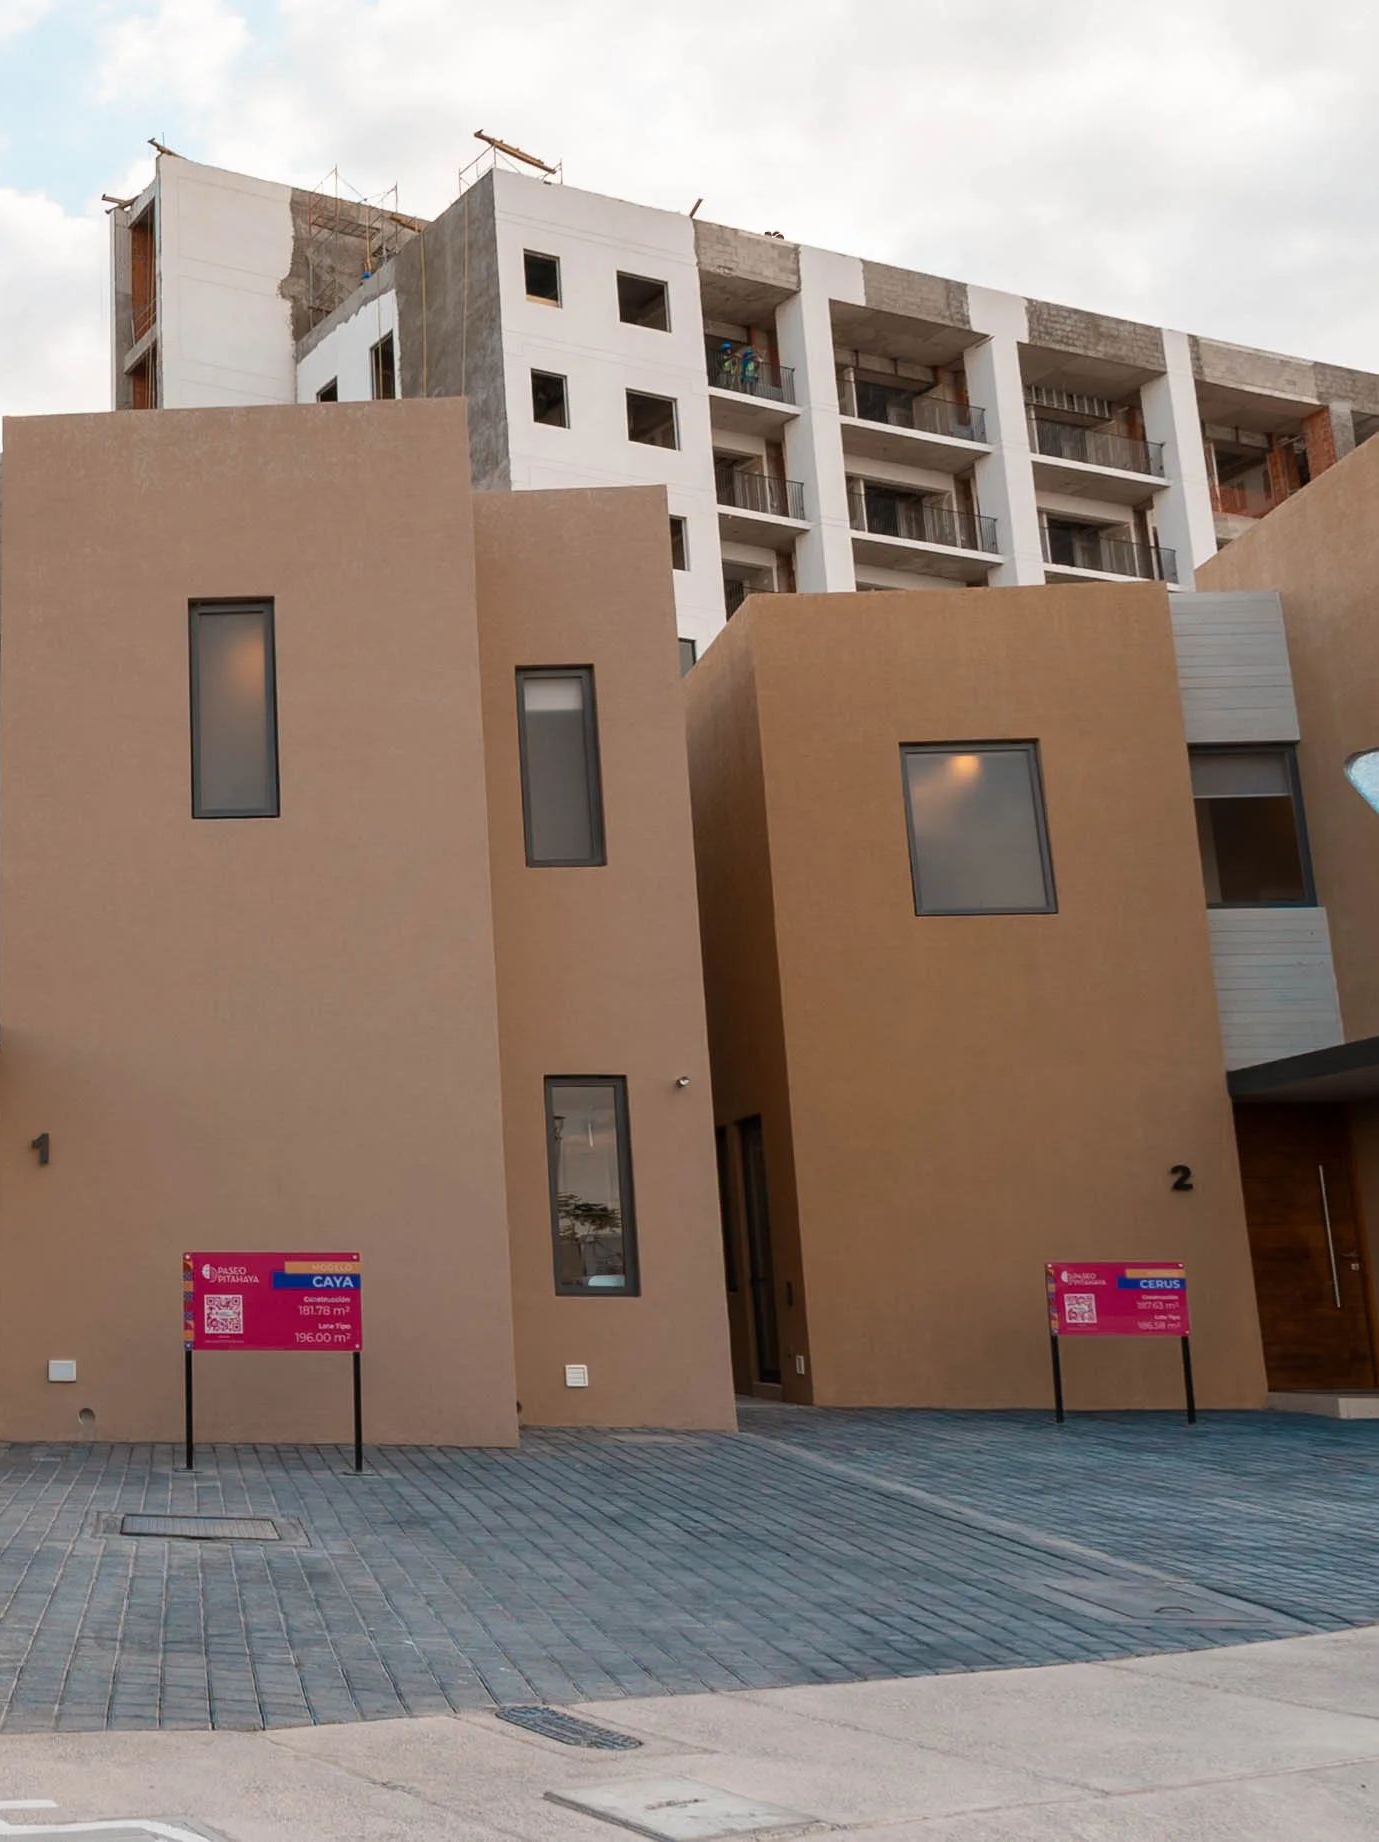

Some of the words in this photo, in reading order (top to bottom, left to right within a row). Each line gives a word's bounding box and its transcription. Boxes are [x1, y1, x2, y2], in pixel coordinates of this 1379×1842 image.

[31, 1133, 49, 1165] 1
[1170, 1165, 1193, 1191] 2
[218, 1267, 247, 1275] PASEO
[312, 1276, 354, 1288] CAYA
[1140, 1280, 1180, 1288] CERUS
[299, 1305, 331, 1316] 181.78
[295, 1333, 331, 1343] 196.00
